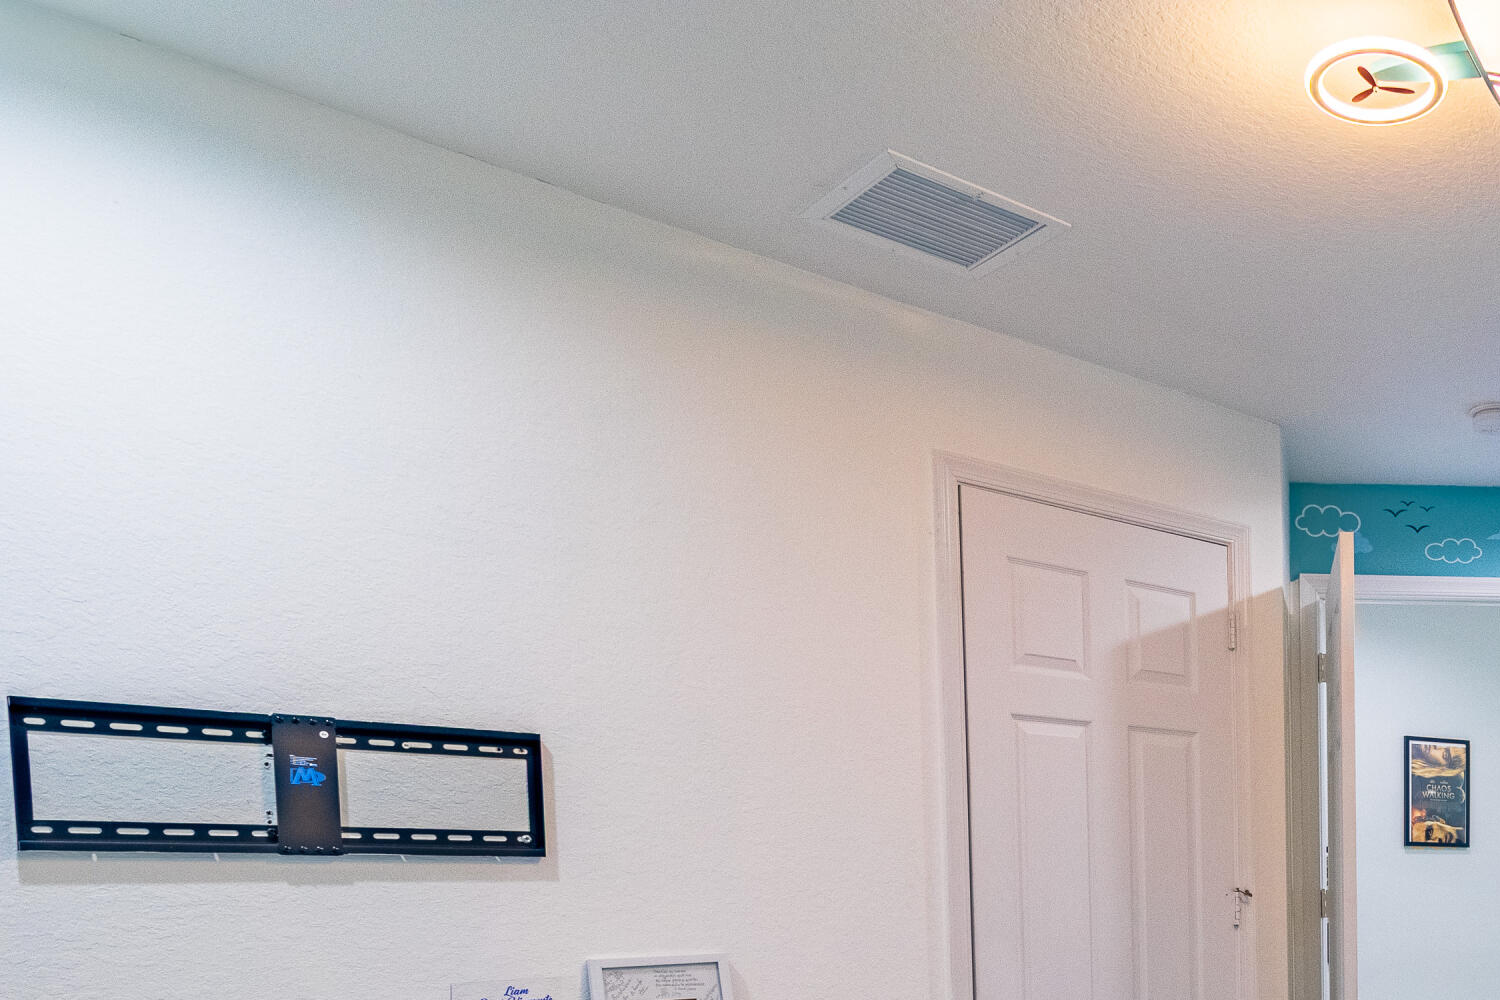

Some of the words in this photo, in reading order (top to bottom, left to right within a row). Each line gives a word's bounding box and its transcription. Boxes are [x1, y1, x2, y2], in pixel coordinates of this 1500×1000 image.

[1426, 784, 1452, 792] CHAOS
[1422, 791, 1455, 799] WALKING
[504, 985, 529, 997] Liam
